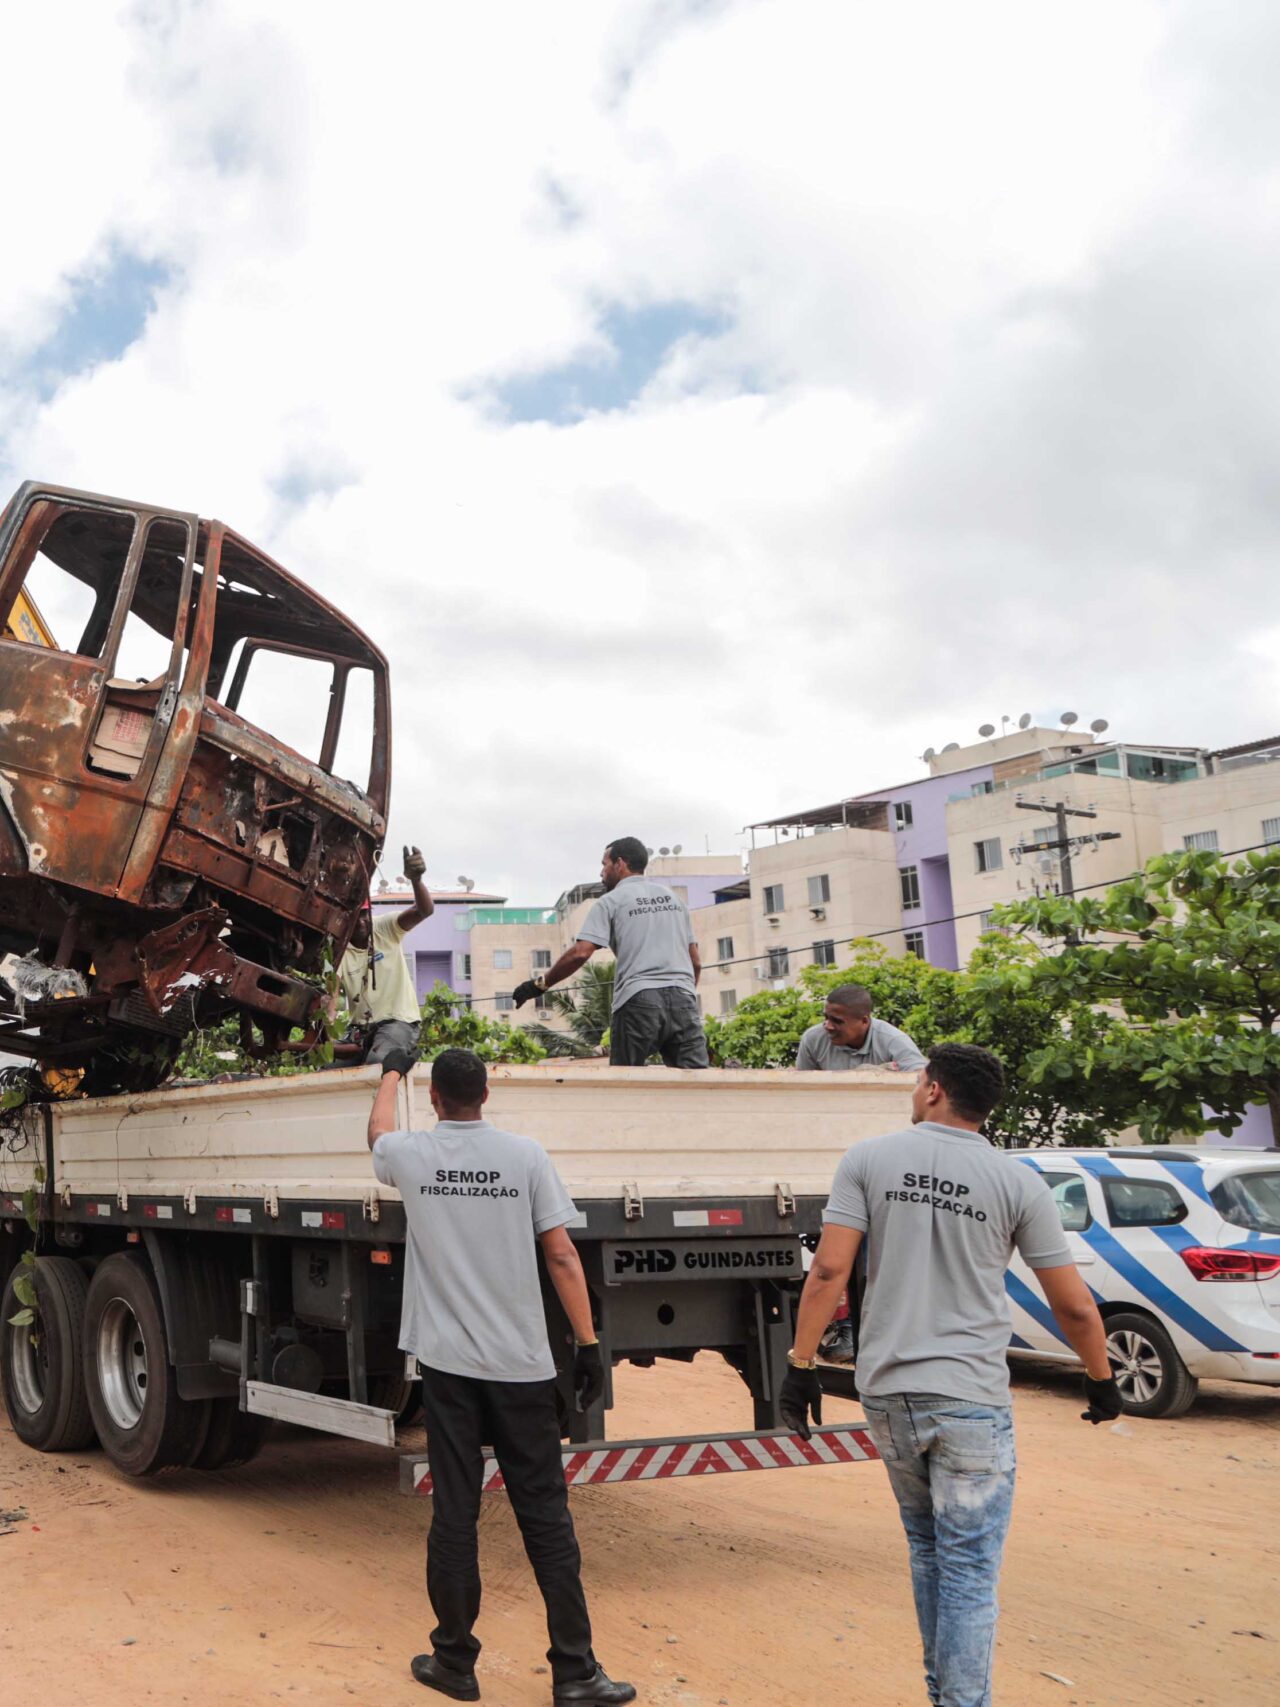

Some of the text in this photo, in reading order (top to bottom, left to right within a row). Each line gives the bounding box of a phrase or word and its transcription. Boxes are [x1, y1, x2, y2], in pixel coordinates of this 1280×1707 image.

[436, 1169, 501, 1184] SEMOP
[420, 1186, 519, 1199] FISCALIZAÇÃO
[885, 1191, 987, 1222] FISCAZAÇÃO
[614, 1249, 794, 1274] PHD GUINDASTES
